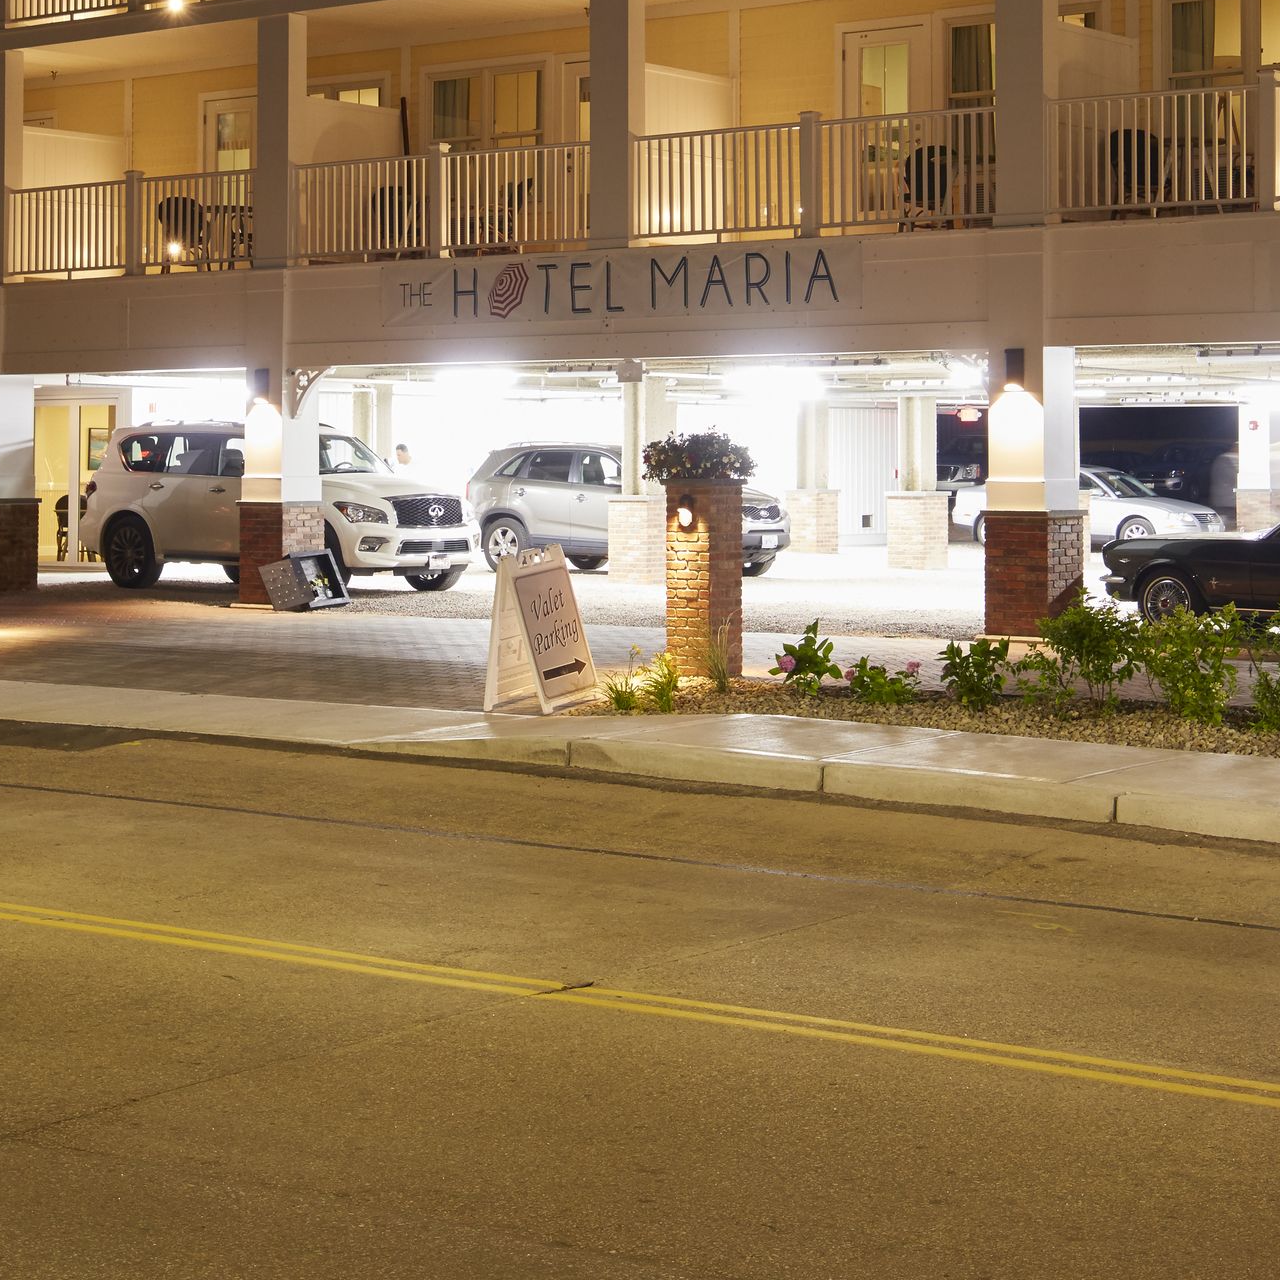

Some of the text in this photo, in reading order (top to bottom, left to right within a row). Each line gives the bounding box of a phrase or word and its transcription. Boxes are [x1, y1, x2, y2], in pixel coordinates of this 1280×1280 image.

[399, 249, 840, 319] THE HOTEL MARIA
[531, 587, 565, 620] Valet
[534, 619, 578, 655] Parking
